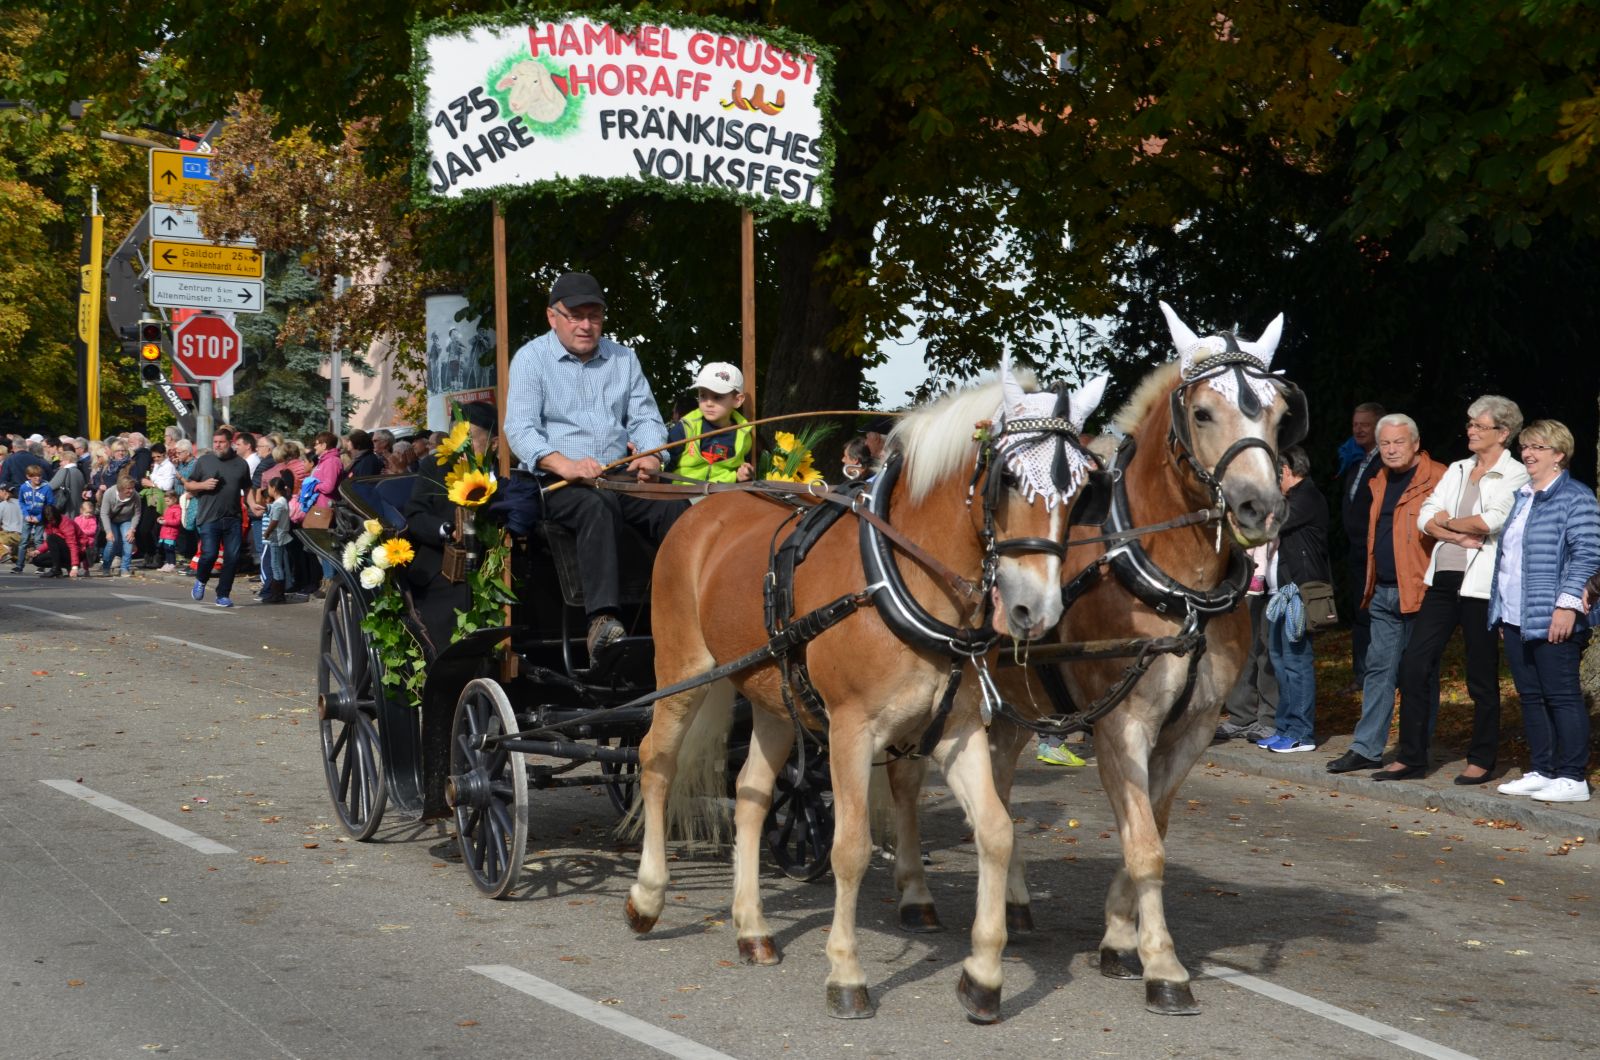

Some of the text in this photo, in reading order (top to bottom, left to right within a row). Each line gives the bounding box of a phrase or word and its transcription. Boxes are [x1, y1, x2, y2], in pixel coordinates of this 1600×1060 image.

[528, 23, 817, 85] HAMMEL GRÜSST
[569, 63, 712, 102] HORAFF
[434, 86, 499, 140] 175
[431, 115, 535, 194] JAHRE
[599, 104, 822, 169] FRÄNKISCHES
[632, 147, 817, 204] VOLKSFEST
[182, 248, 222, 259] Gaildorf
[232, 252, 243, 261] 25
[182, 260, 256, 273] Frankenhardt 4 km
[157, 291, 213, 302] Altenmünster
[178, 283, 213, 293] Zentrum
[182, 334, 234, 360] STOP
